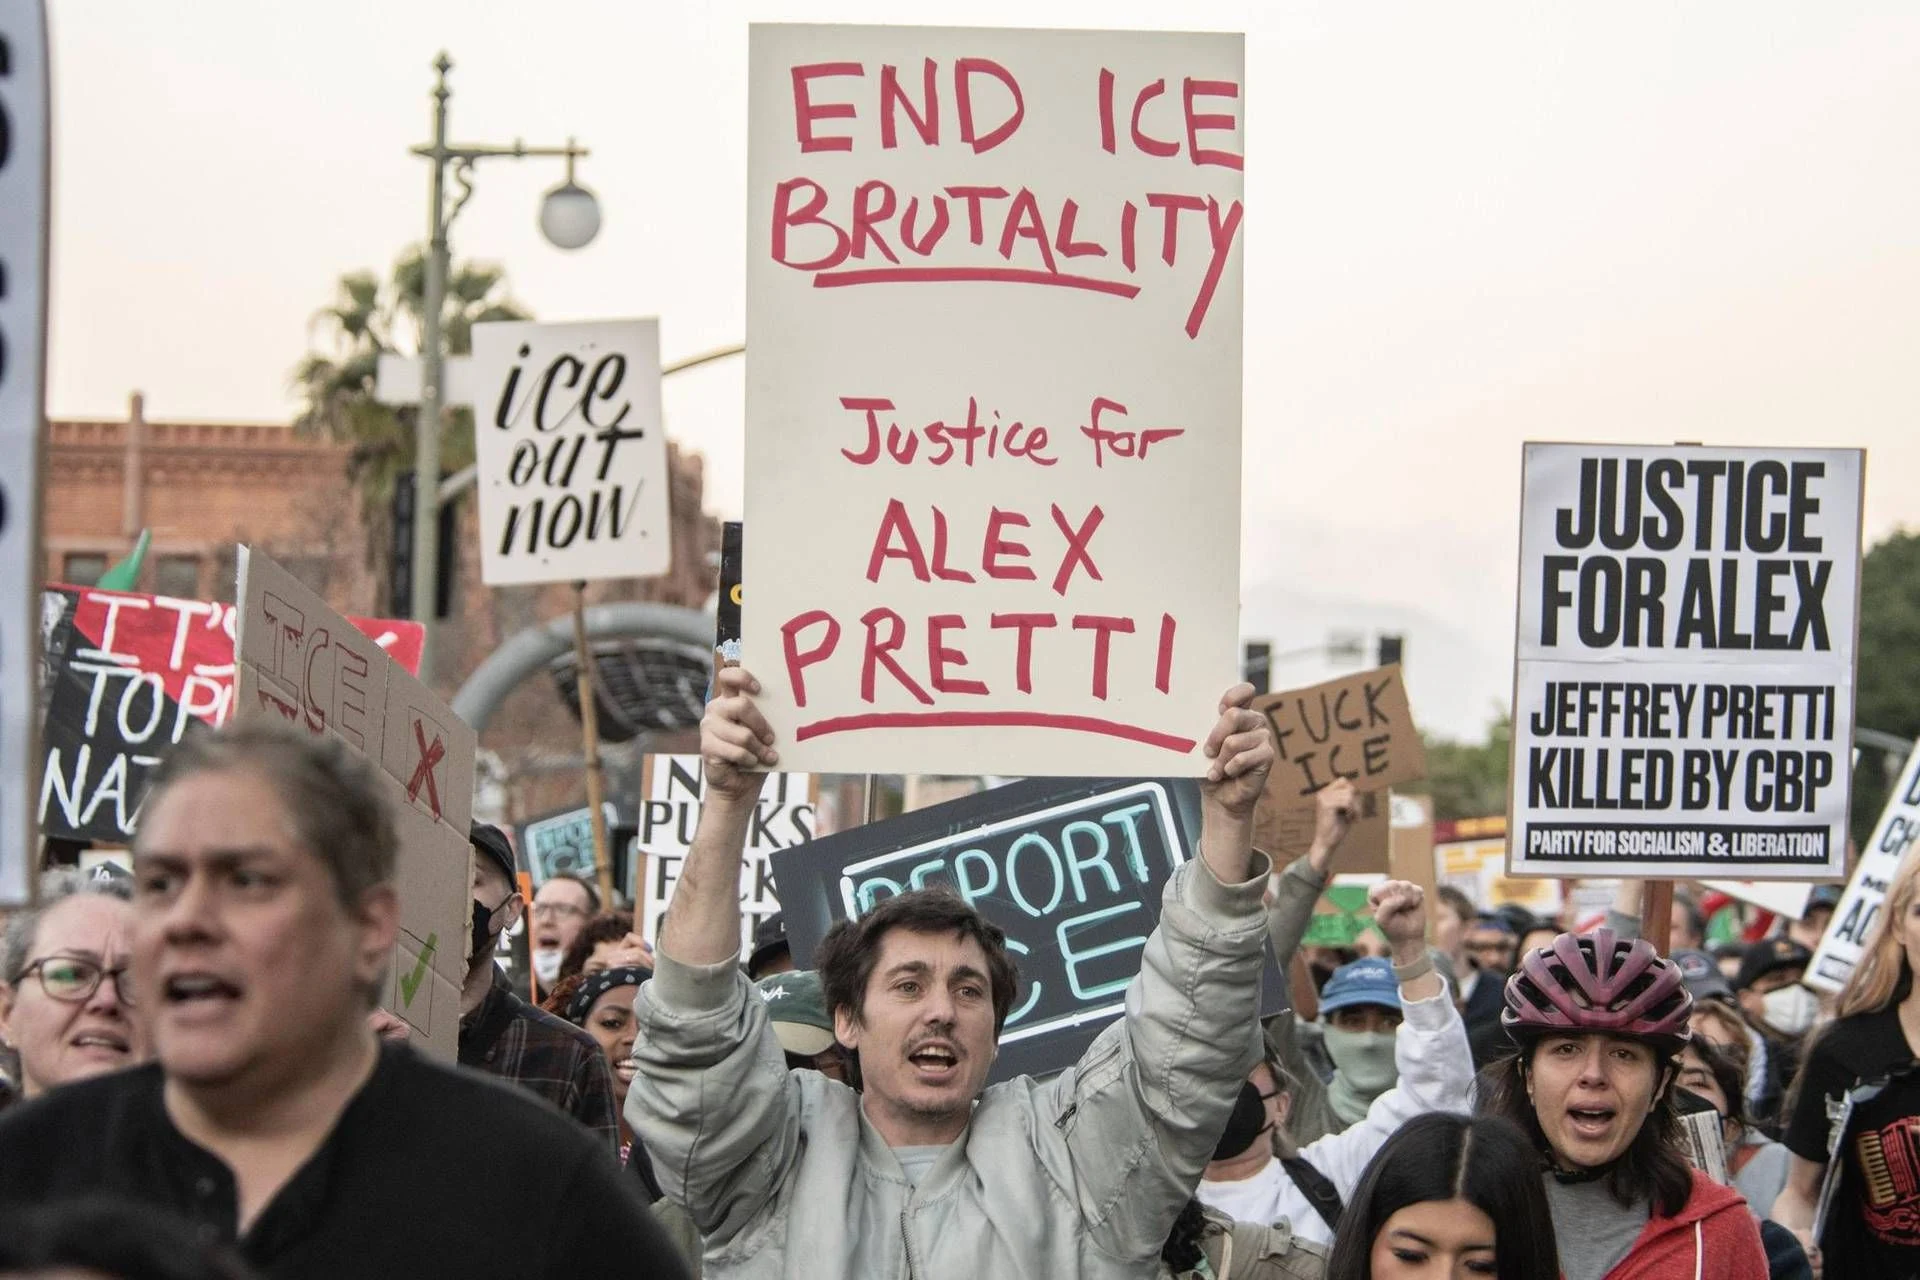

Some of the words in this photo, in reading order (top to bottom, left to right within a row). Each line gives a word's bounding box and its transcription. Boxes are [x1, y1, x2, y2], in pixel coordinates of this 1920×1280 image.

[791, 57, 1024, 155] END
[1099, 66, 1244, 171] ICE
[771, 176, 1244, 340] BRUTALITY
[496, 343, 631, 431] ice
[507, 424, 644, 488] out
[839, 396, 1058, 467] Justice
[1080, 396, 1185, 468] for
[866, 498, 1104, 597] ALEX
[1555, 457, 1825, 554] JUSTICE
[1540, 555, 1667, 649] FOR
[1674, 557, 1833, 651] ALEX
[256, 590, 369, 752] ICE
[781, 607, 1177, 708] PRETTI
[69, 660, 165, 744] TO
[1264, 675, 1391, 761] FUCK
[1529, 681, 1697, 739] JEFFREY
[1701, 683, 1835, 741] PRETTI
[668, 756, 788, 803] NI
[1293, 733, 1391, 796] ICE
[1528, 746, 1674, 811] KILLED
[1681, 748, 1740, 811] BY
[1744, 748, 1833, 813] CBP
[643, 800, 815, 849] PUKS
[1529, 829, 1583, 855] PARTY
[1584, 830, 1616, 855] FOR
[1617, 830, 1704, 856] SOCIALISM
[1707, 833, 1729, 857] &
[1731, 832, 1824, 858] LIBERATION
[656, 855, 779, 903] FK
